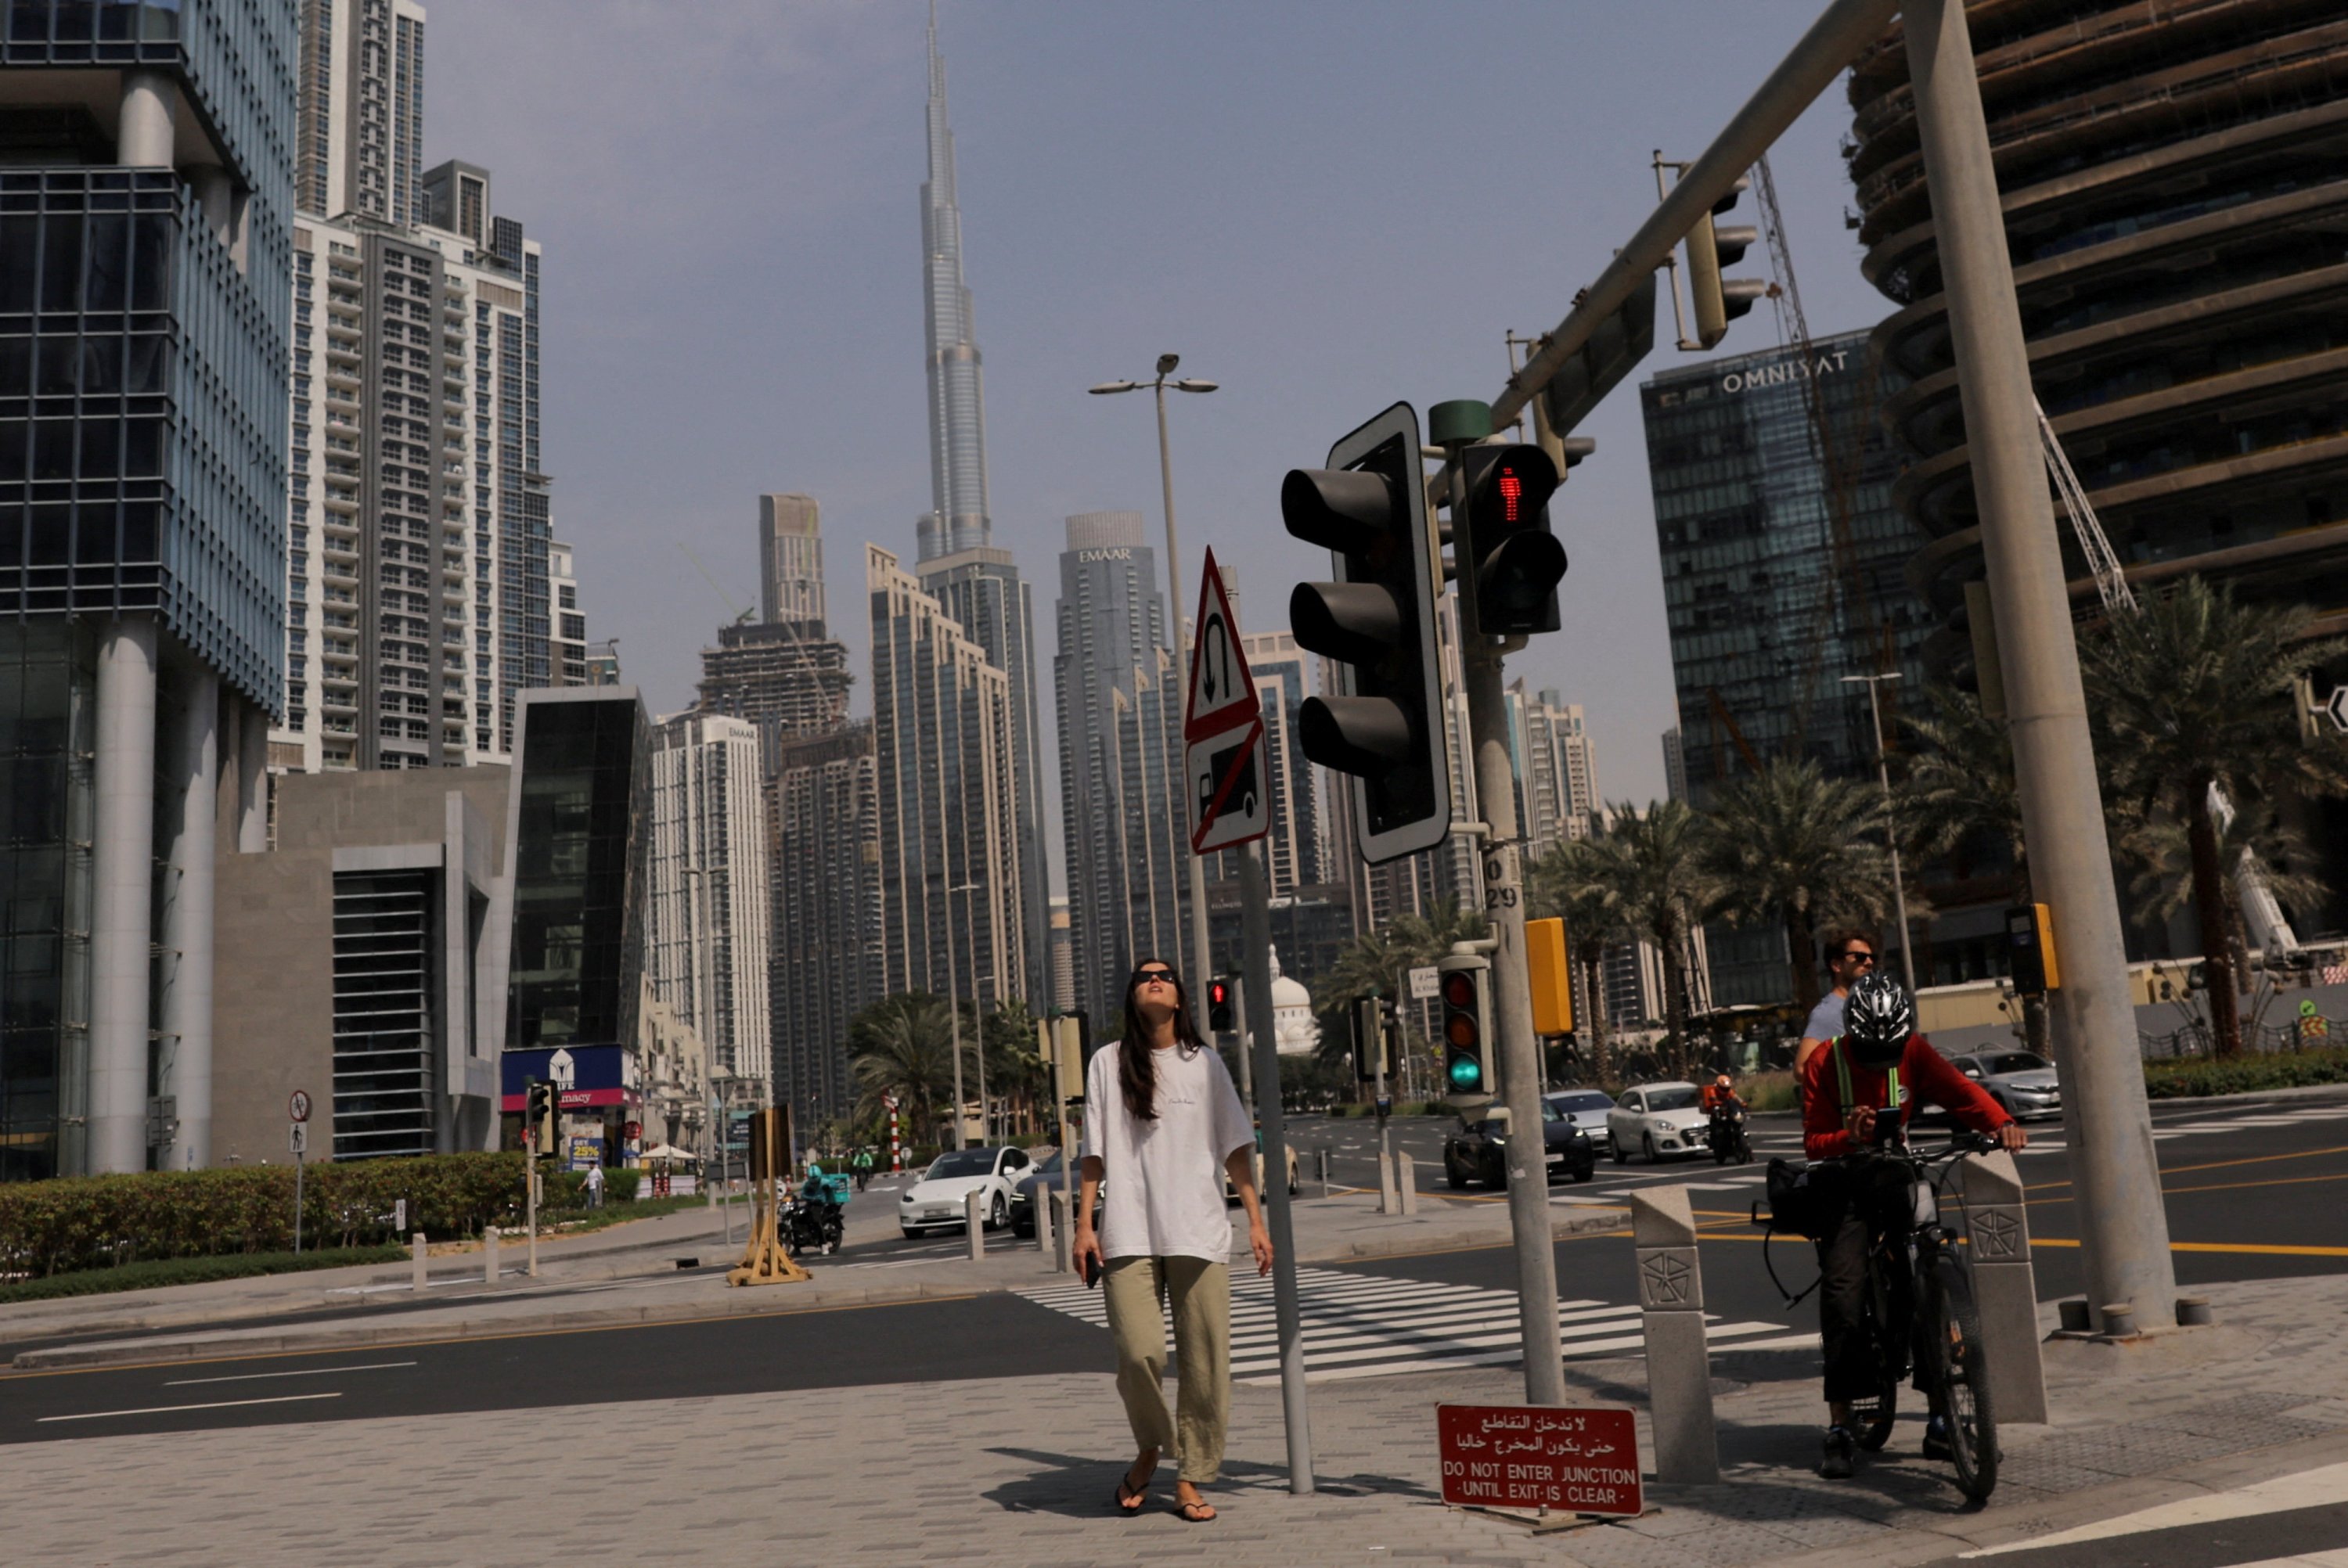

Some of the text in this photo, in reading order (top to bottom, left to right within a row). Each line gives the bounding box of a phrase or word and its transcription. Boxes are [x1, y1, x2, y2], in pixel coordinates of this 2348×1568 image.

[1723, 351, 1848, 393] OMNIYAT
[1080, 548, 1131, 563] EMAAR
[729, 727, 756, 740] EMAAR
[1486, 886, 1517, 908] 29
[556, 1082, 575, 1091] IFE
[573, 1145, 600, 1156] 25%
[1481, 1414, 1586, 1433] لا تدخل التقاطع
[1456, 1433, 1615, 1457] حتى يكون المخرج خاليا
[1443, 1461, 1637, 1485] DO NOT ENTER JUNCTION
[1462, 1481, 1617, 1504] UNTIL EXIT IS CLEAR
